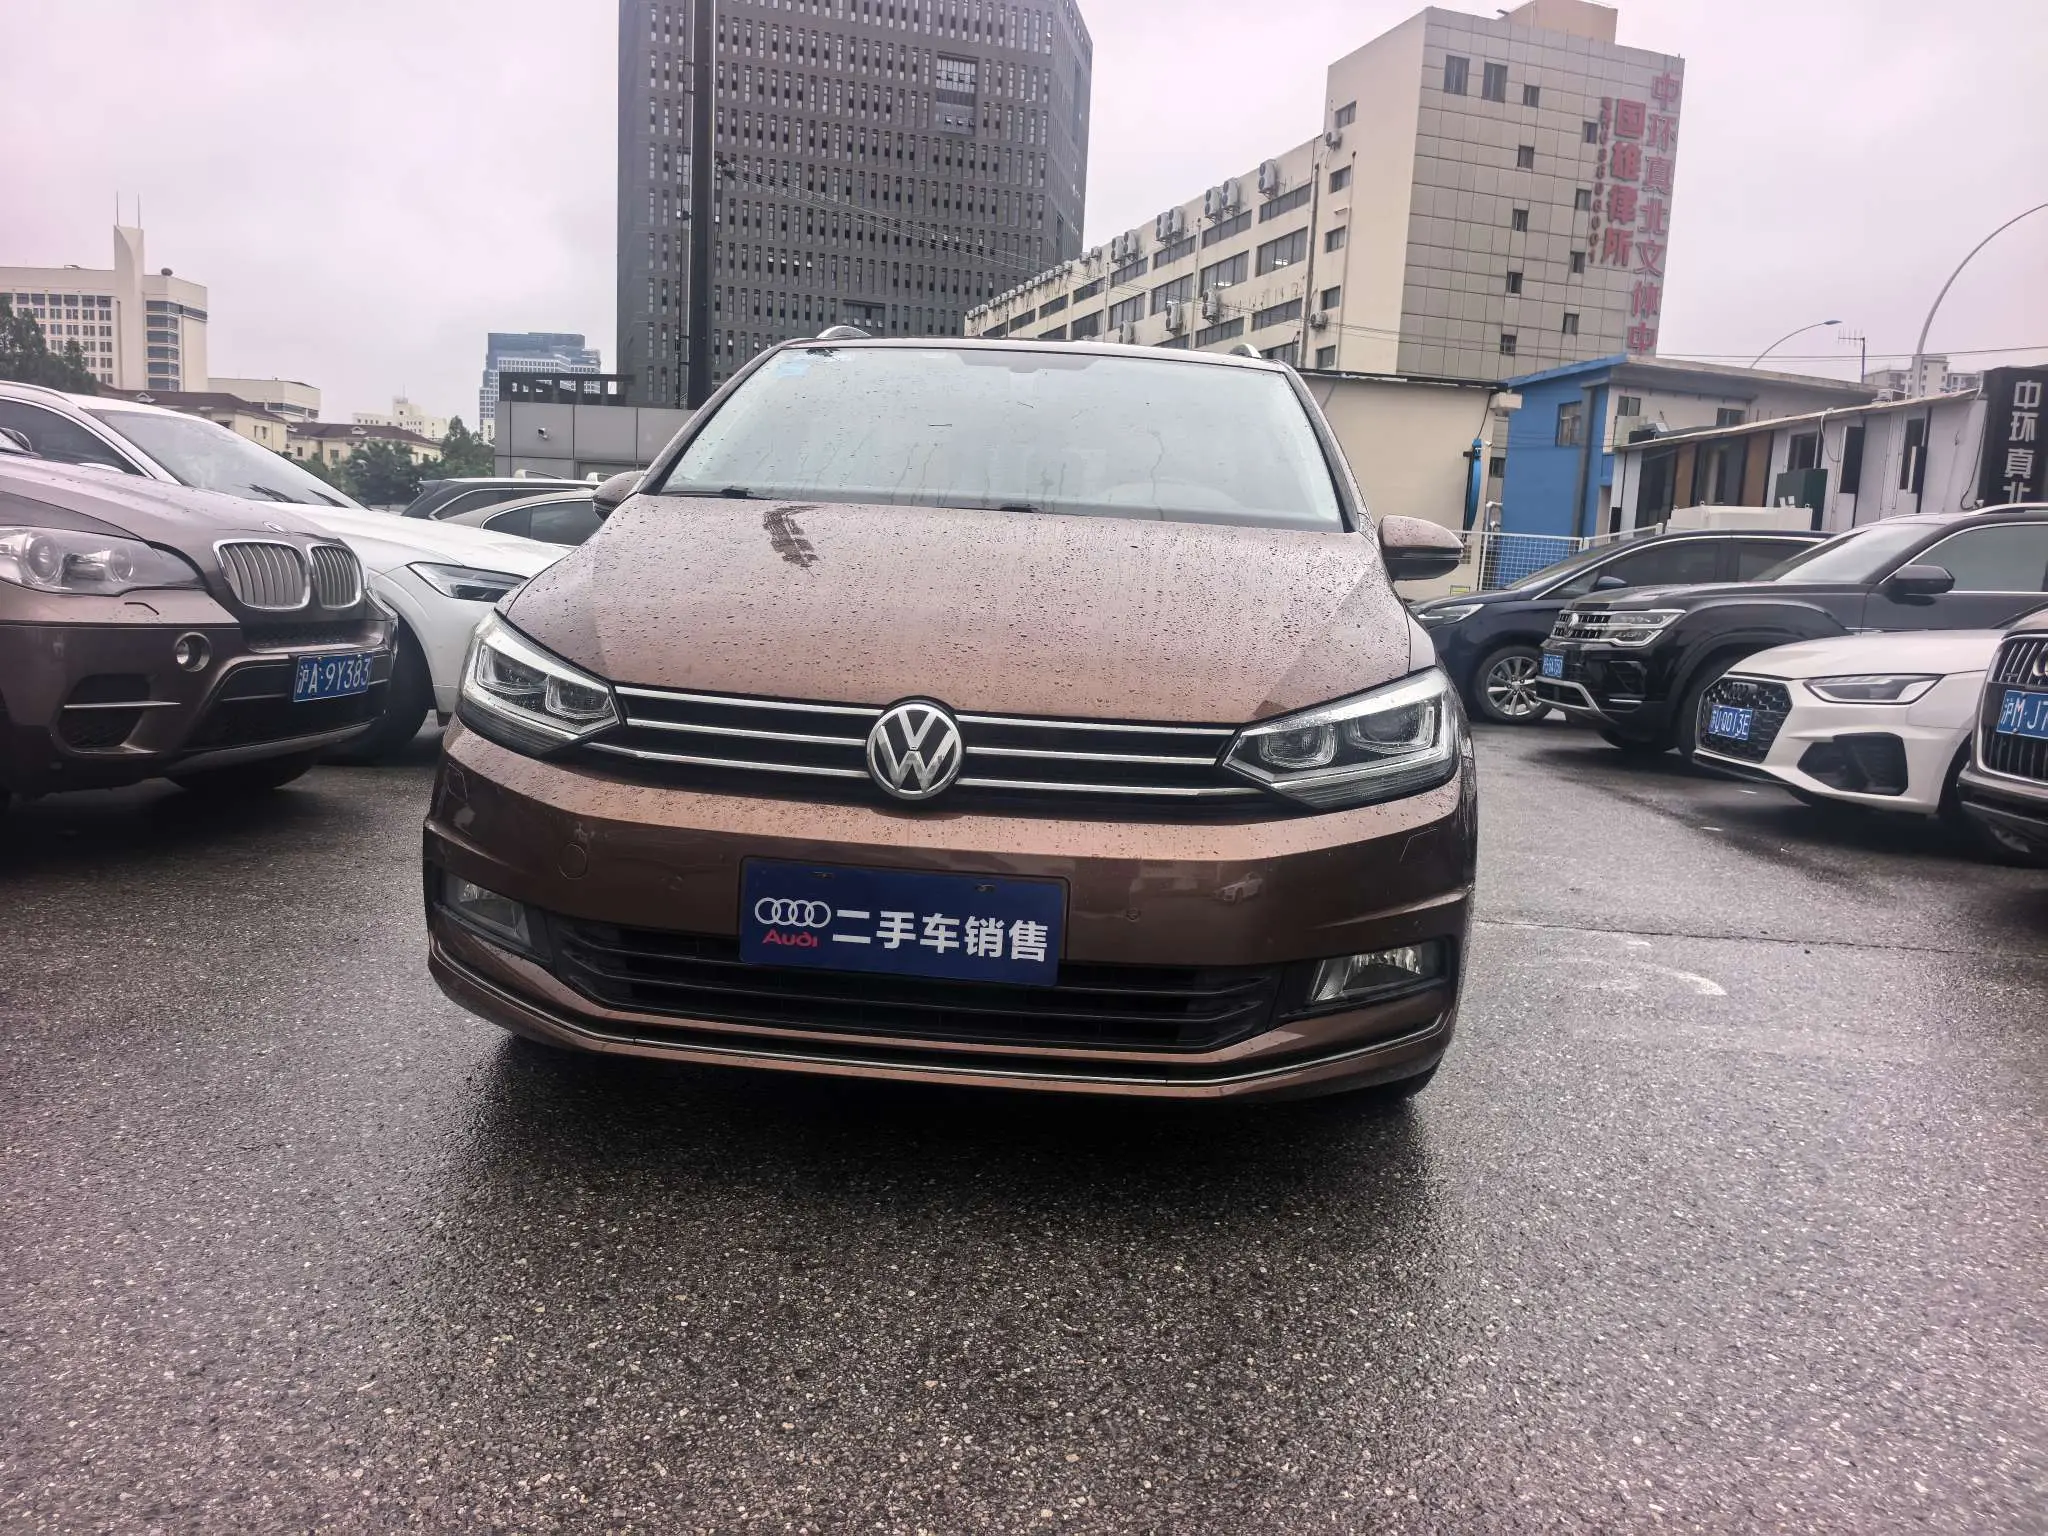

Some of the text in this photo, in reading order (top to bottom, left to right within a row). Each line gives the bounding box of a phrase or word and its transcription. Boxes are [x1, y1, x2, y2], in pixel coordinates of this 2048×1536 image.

[762, 928, 818, 948] Audi
[832, 909, 1049, 962] 二手车销售
